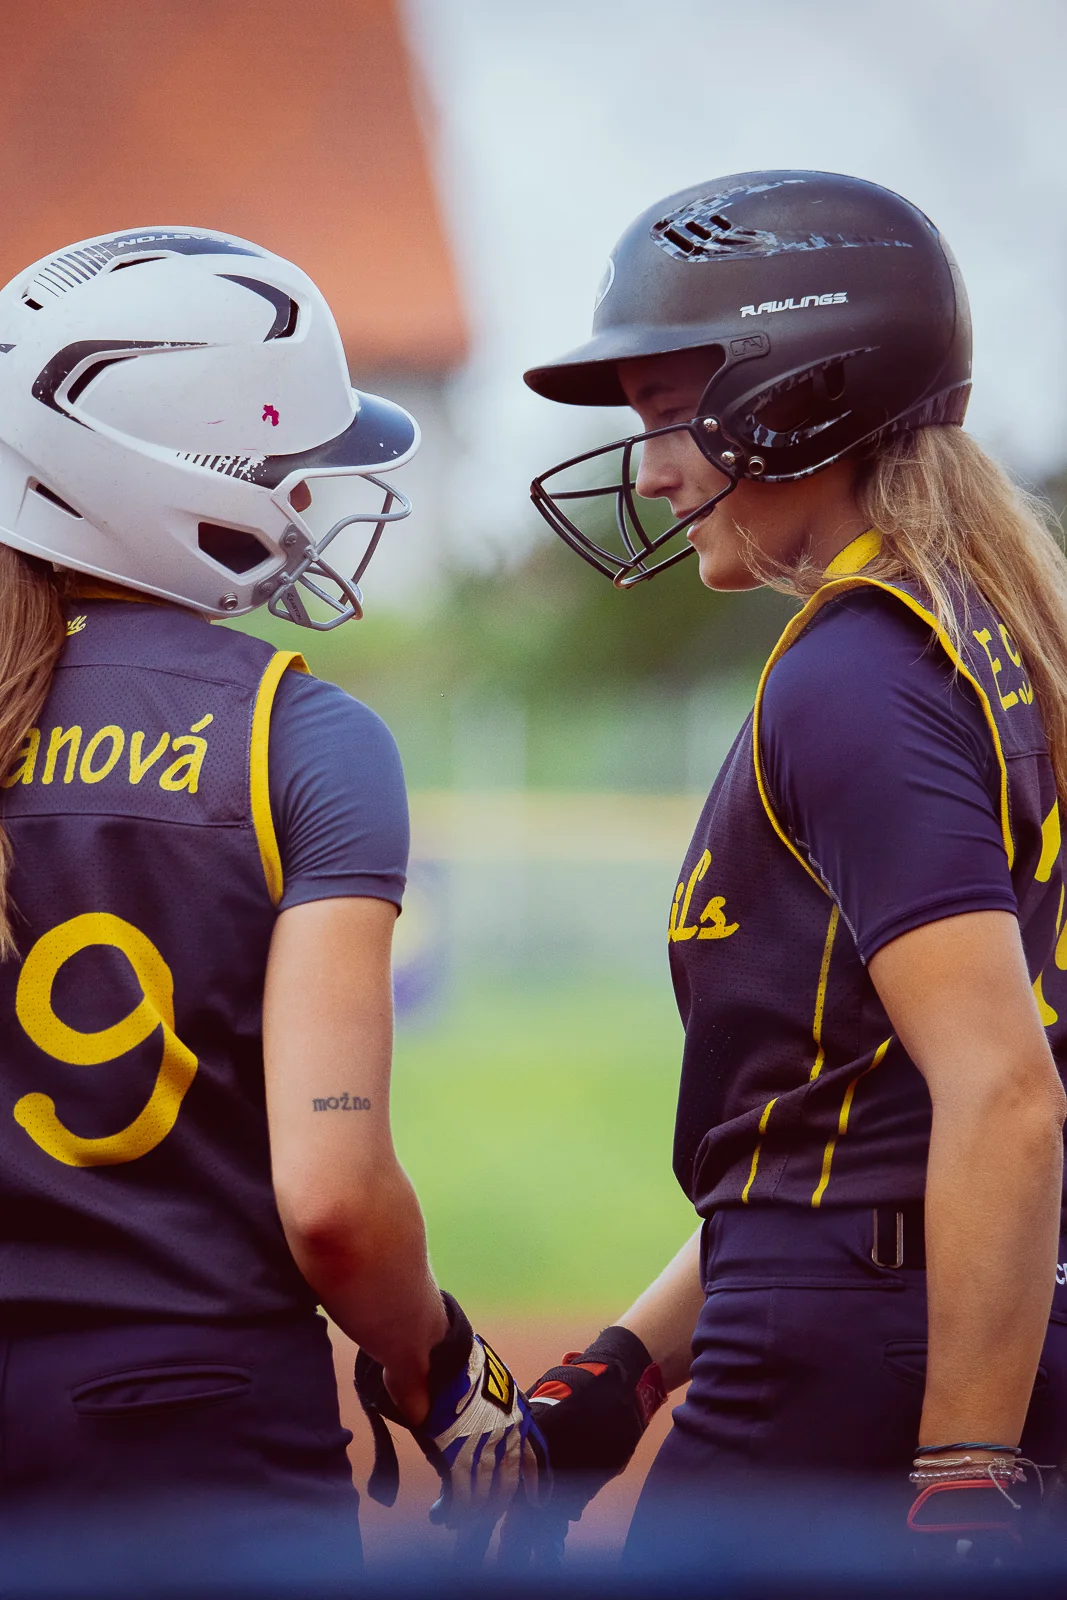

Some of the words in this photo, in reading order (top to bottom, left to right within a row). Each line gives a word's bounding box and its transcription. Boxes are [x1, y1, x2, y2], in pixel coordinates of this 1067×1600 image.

[116, 234, 225, 249] ASTON
[740, 292, 847, 318] RAWLINGS
[13, 912, 199, 1168] 9
